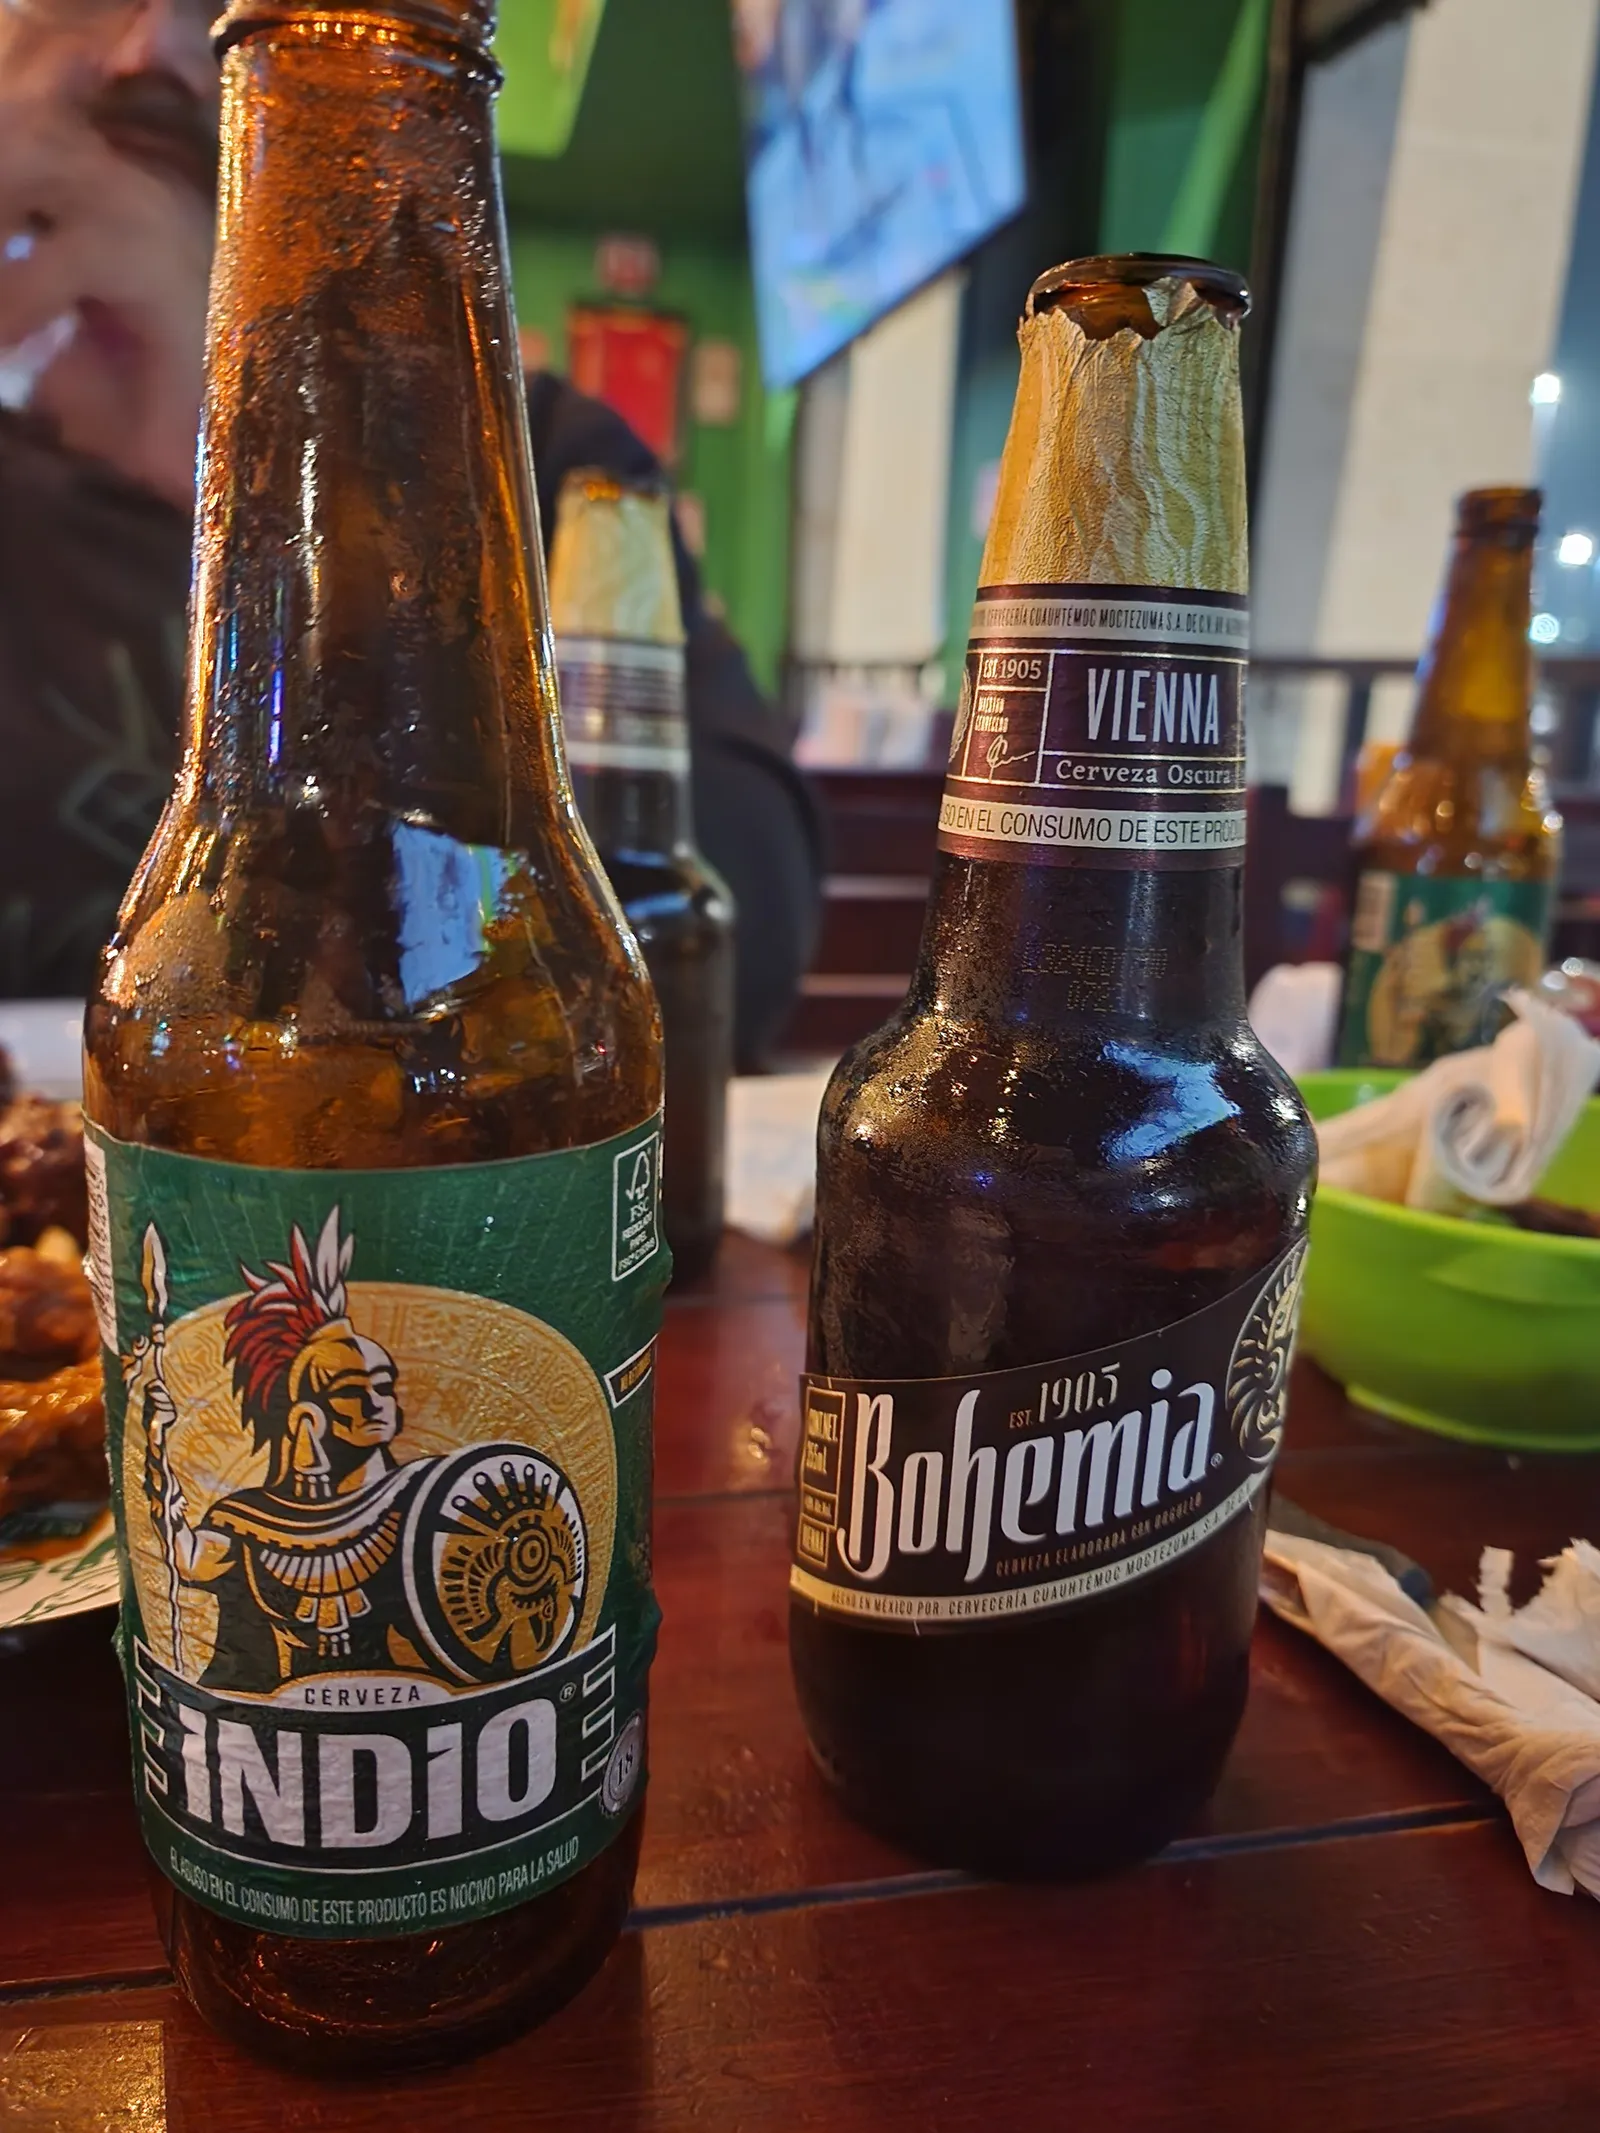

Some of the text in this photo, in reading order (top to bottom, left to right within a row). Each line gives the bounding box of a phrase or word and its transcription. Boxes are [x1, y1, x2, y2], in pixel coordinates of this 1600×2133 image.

[1029, 605, 1096, 628] CUAUHTÉMOC
[1099, 608, 1164, 630] MOCTEZUMA
[999, 659, 1042, 680] 1905
[1087, 668, 1219, 745] VIENNA
[1056, 760, 1232, 785] Cerveza Oscura
[957, 806, 975, 830] EN
[977, 809, 995, 833] EL
[1000, 811, 1112, 842] CONSUMO
[1119, 819, 1148, 843] DE
[1153, 819, 1201, 844] ESTE
[1009, 1362, 1121, 1428] EST. 1905
[837, 1367, 1215, 1582] Bohemia
[995, 1552, 1051, 1578] CERVEZA
[1055, 1528, 1127, 1564] ELABORADA
[1154, 1491, 1202, 1528] ORGULLO
[859, 1597, 871, 1610] EN
[873, 1596, 914, 1614] MÉXICO
[948, 1590, 1028, 1615] CERVECERÍA
[1033, 1566, 1122, 1604] CUAUHTÉMOC
[304, 1684, 422, 1708] CERVEZA
[169, 1835, 580, 1925] EL ABUSO EN EL CONSUMO DE ESTE PRODUCTO ES NOCIVO PARA LA SALUD
